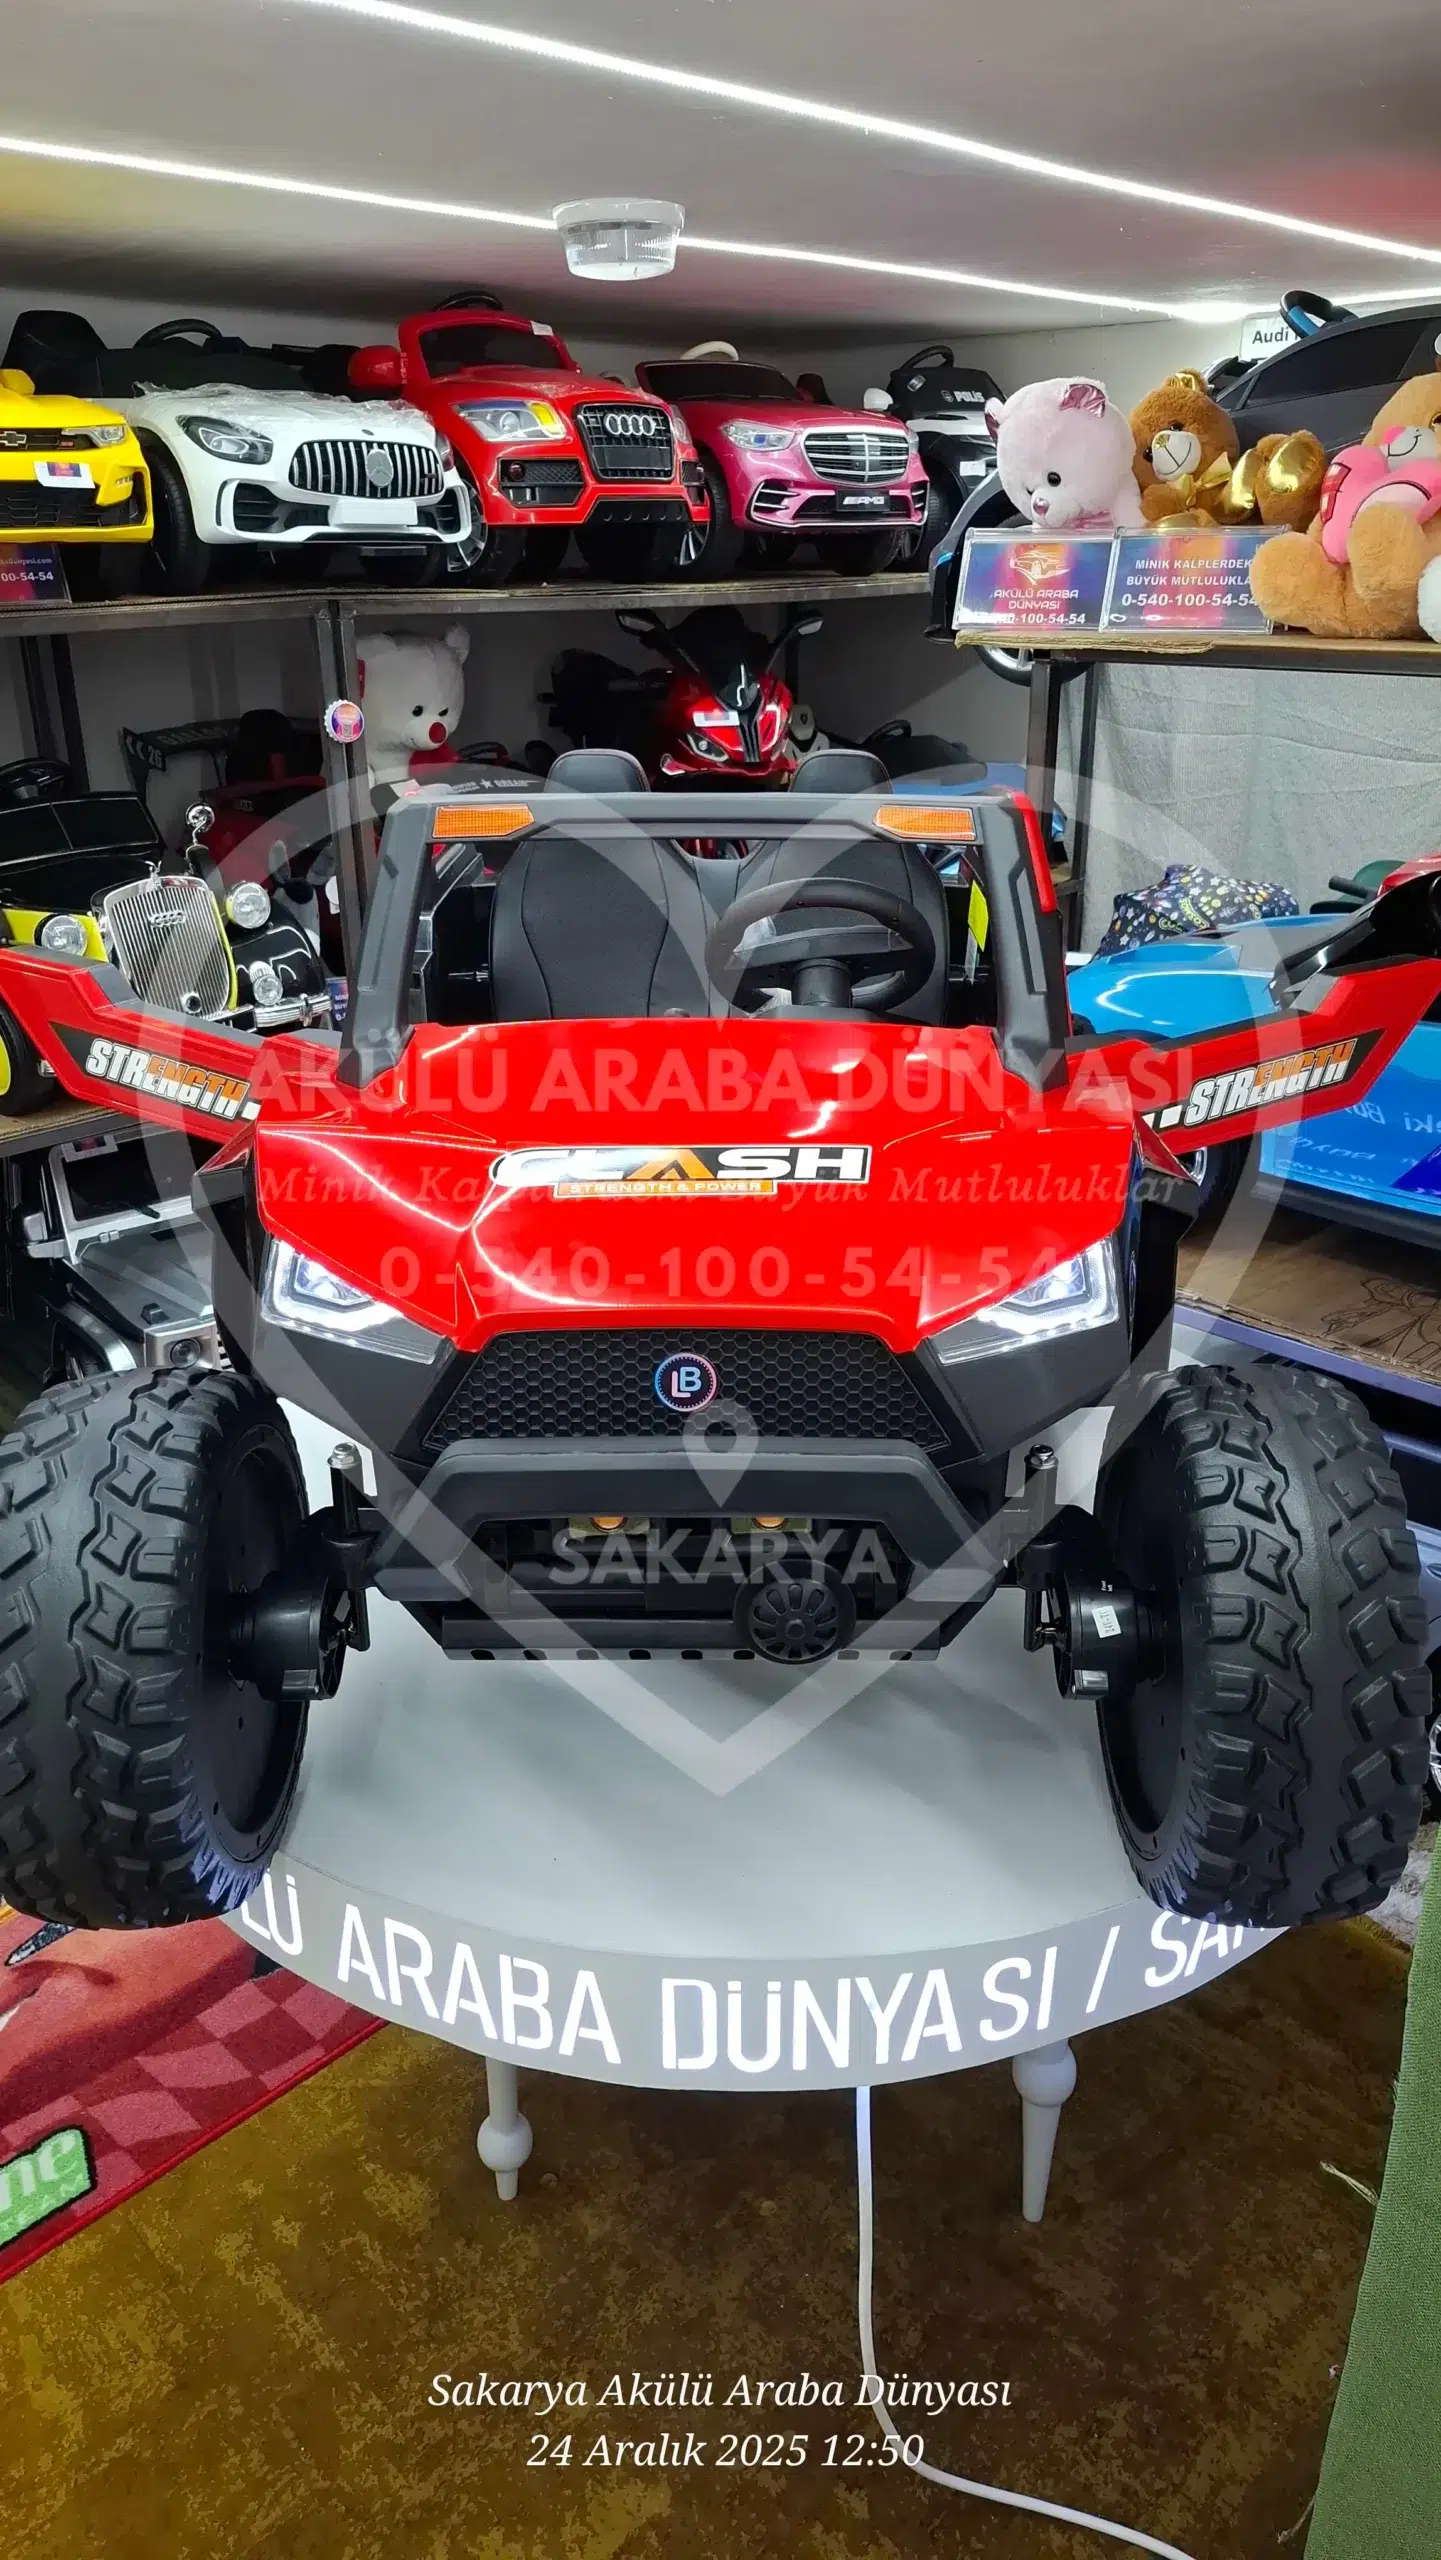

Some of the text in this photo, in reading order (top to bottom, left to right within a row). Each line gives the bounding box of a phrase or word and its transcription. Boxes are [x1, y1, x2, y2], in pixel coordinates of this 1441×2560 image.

[1252, 326, 1289, 344] Audi
[1173, 558, 1251, 569] KALPLERDEK
[1126, 574, 1251, 586] BÜYÜK MUTLULUKLA
[993, 588, 1079, 599] AKÜLÜ ARABA
[1121, 593, 1258, 606] 0-540-100-54-54
[1008, 599, 1061, 610] DÜNYASI
[86, 1038, 250, 1120] STRENGTH
[1184, 1038, 1358, 1126] STRENGTH
[569, 1181, 761, 1194] STRENGTH & POWER
[337, 1903, 622, 2065] ARABA
[661, 1946, 1058, 2073] DÜNYASI
